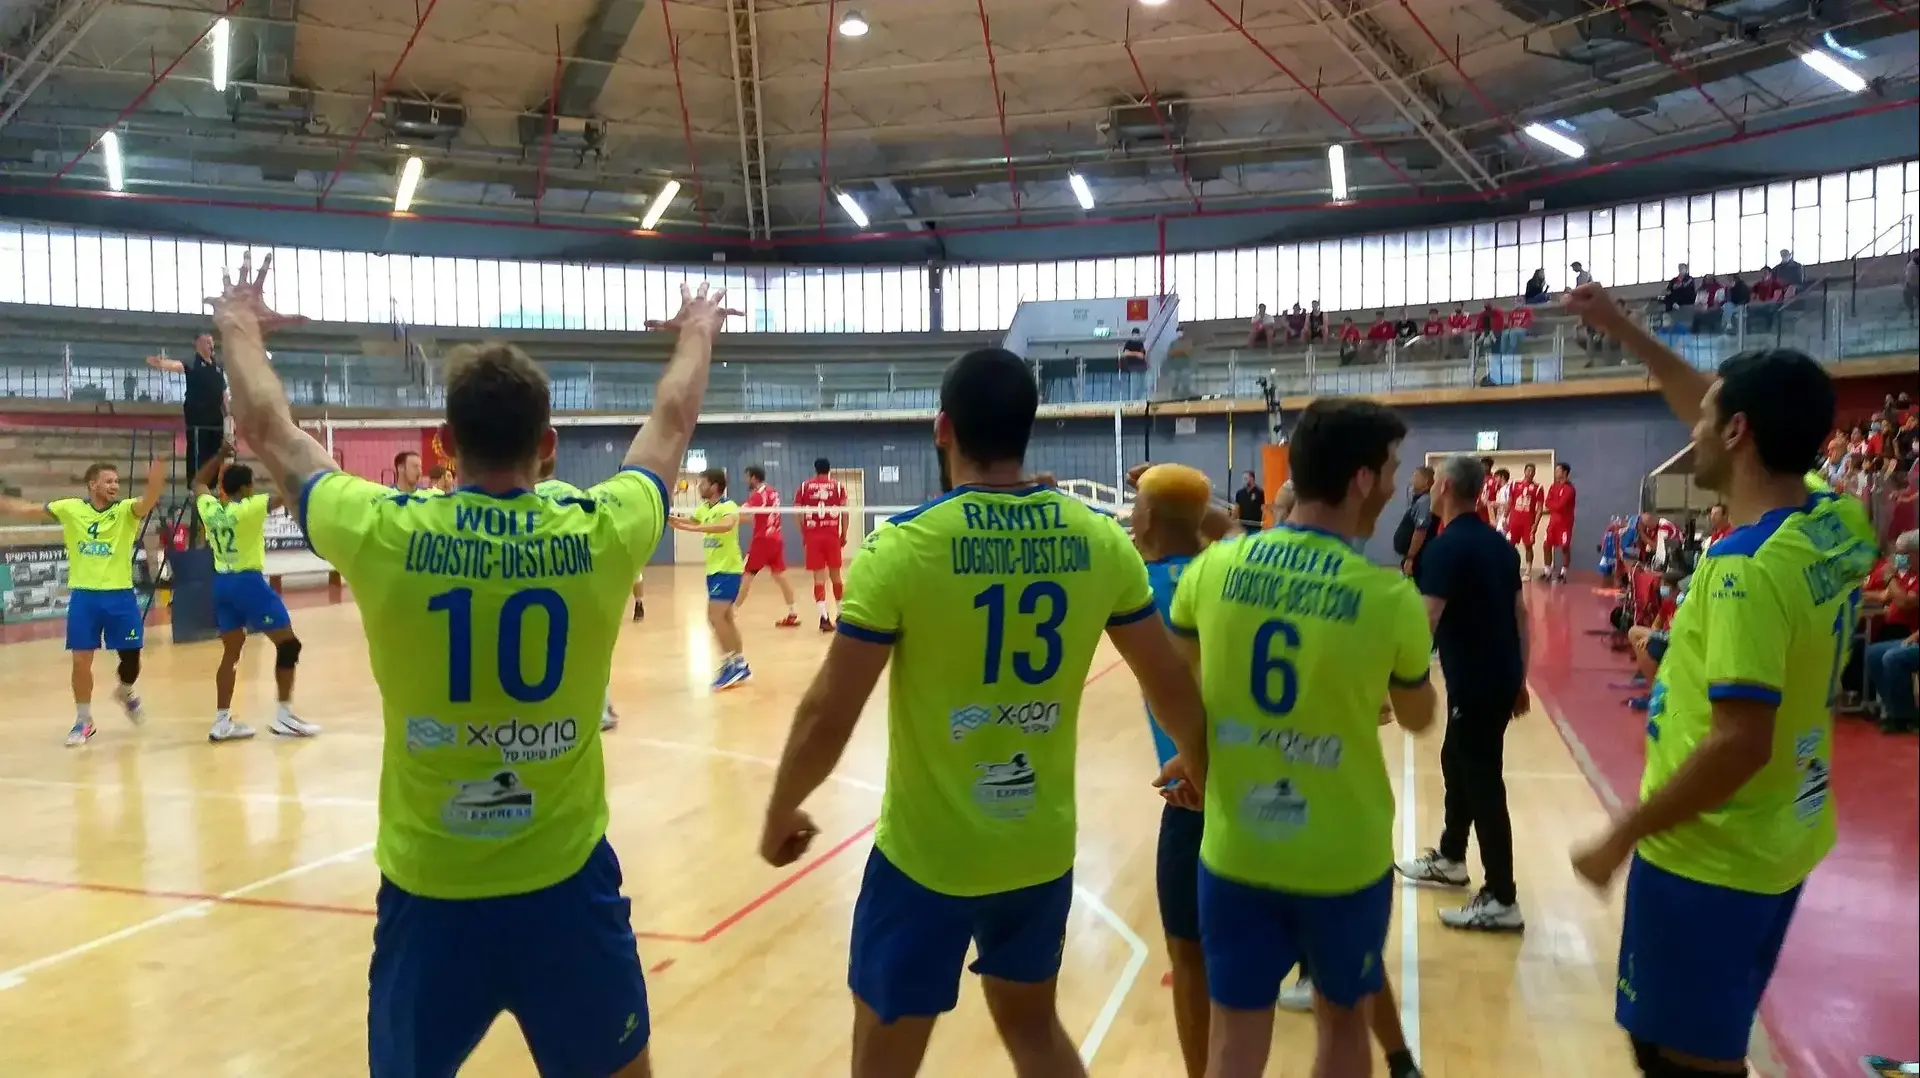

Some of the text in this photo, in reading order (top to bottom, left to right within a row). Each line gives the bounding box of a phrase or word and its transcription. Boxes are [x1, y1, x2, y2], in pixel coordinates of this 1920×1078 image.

[87, 521, 100, 539] 4
[455, 503, 543, 536] WOLF
[963, 502, 1068, 531] RAWITZ
[211, 526, 238, 554] 12
[405, 530, 594, 579] LOGISTIC-DEST.COM
[952, 536, 1092, 576] LOGISTIC-DEST.COM
[427, 586, 569, 703] 10
[973, 580, 1068, 685] 13
[1250, 616, 1301, 716] 6
